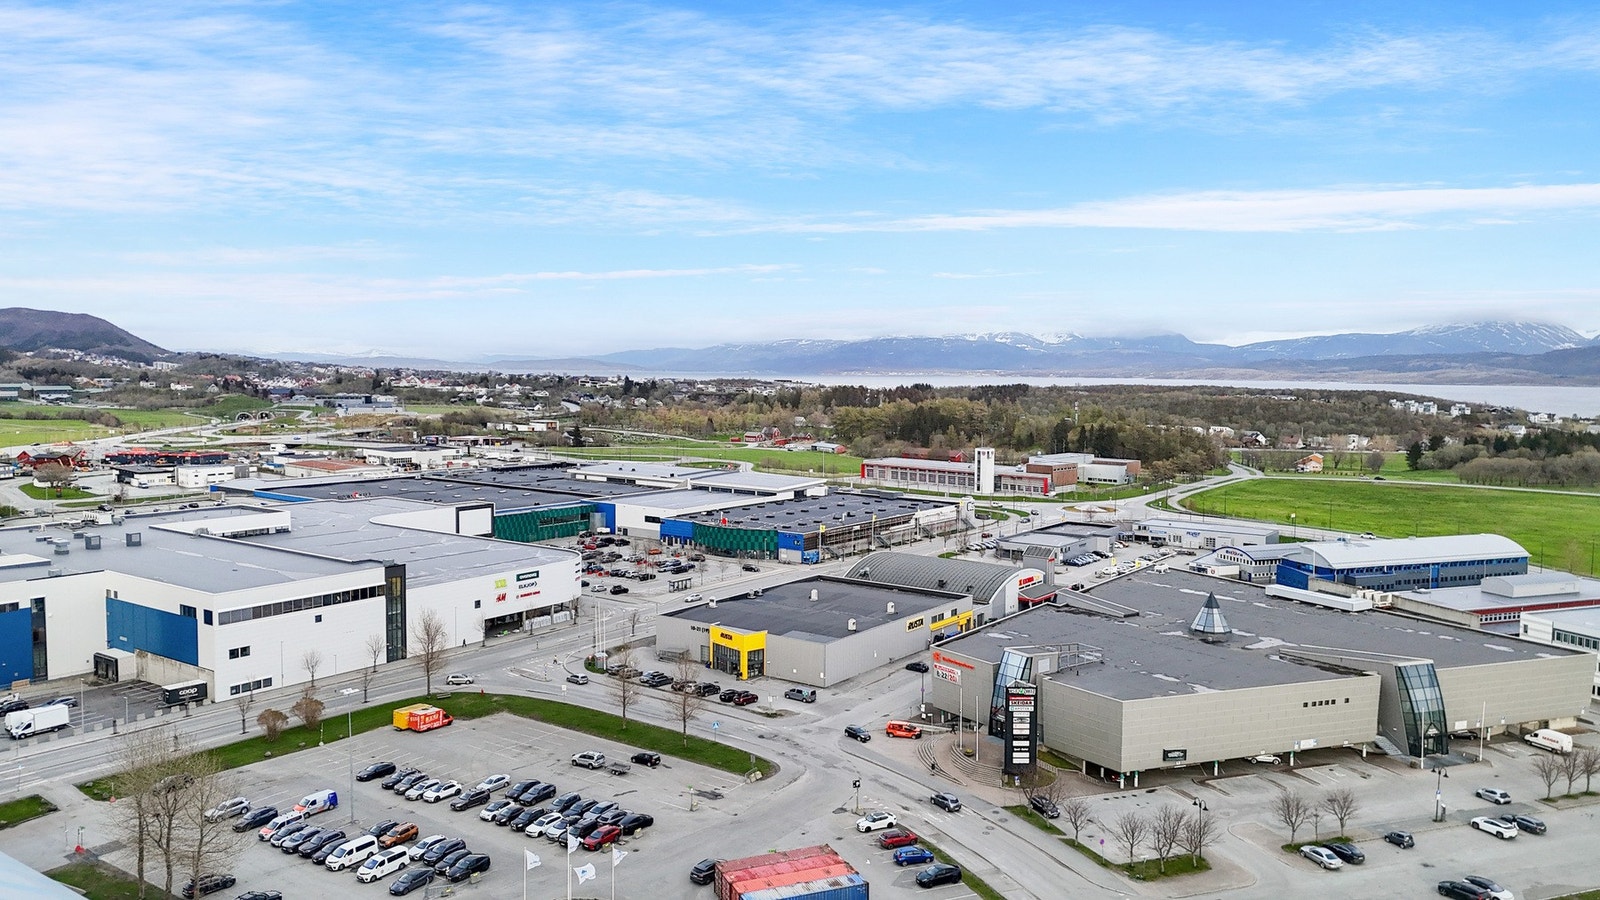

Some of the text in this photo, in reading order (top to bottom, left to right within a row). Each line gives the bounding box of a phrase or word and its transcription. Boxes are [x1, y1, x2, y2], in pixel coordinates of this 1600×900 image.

[907, 618, 924, 631] RUSTA
[720, 632, 733, 641] RUSTA
[179, 687, 198, 696] coop
